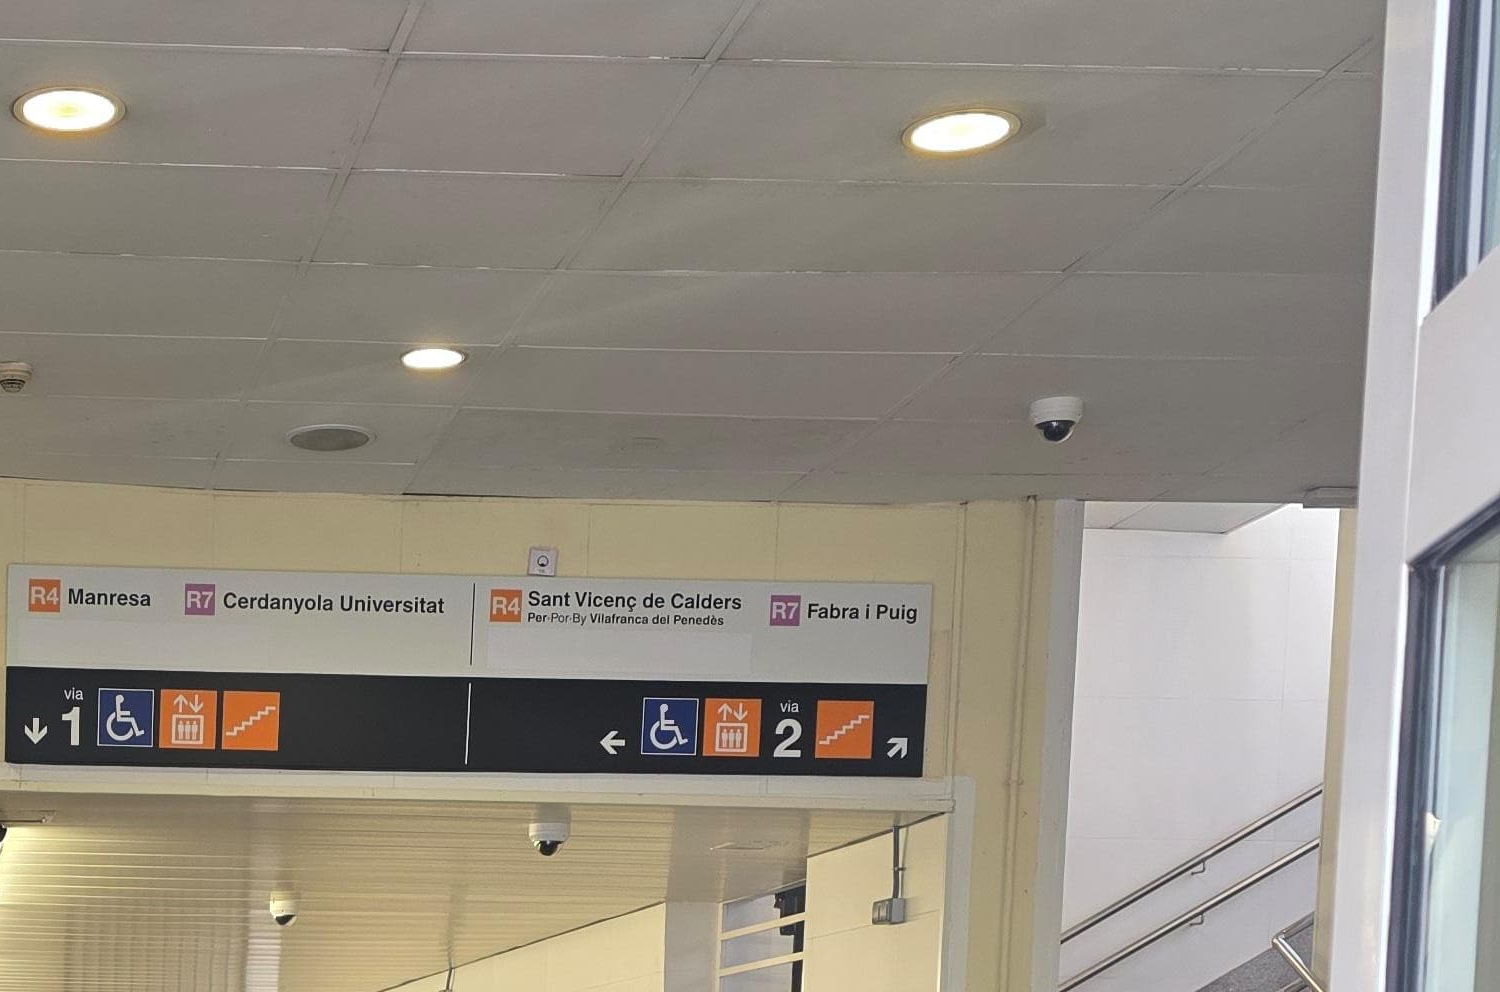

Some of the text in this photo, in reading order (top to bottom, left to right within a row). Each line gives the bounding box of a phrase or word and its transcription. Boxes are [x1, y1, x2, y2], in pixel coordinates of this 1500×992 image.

[30, 586, 151, 608] R4 Manresa
[187, 590, 445, 614] R7 Cerdanyola Universitat
[491, 590, 742, 615] R4 Sant Vicenç de Calders
[590, 613, 649, 626] Vilafranca
[652, 614, 670, 626] del
[673, 614, 725, 626] Penedès
[772, 602, 918, 625] R7 Fabra i Puig
[64, 686, 84, 700] via
[780, 699, 800, 714] via
[62, 706, 81, 746] 1
[773, 720, 801, 758] 2
